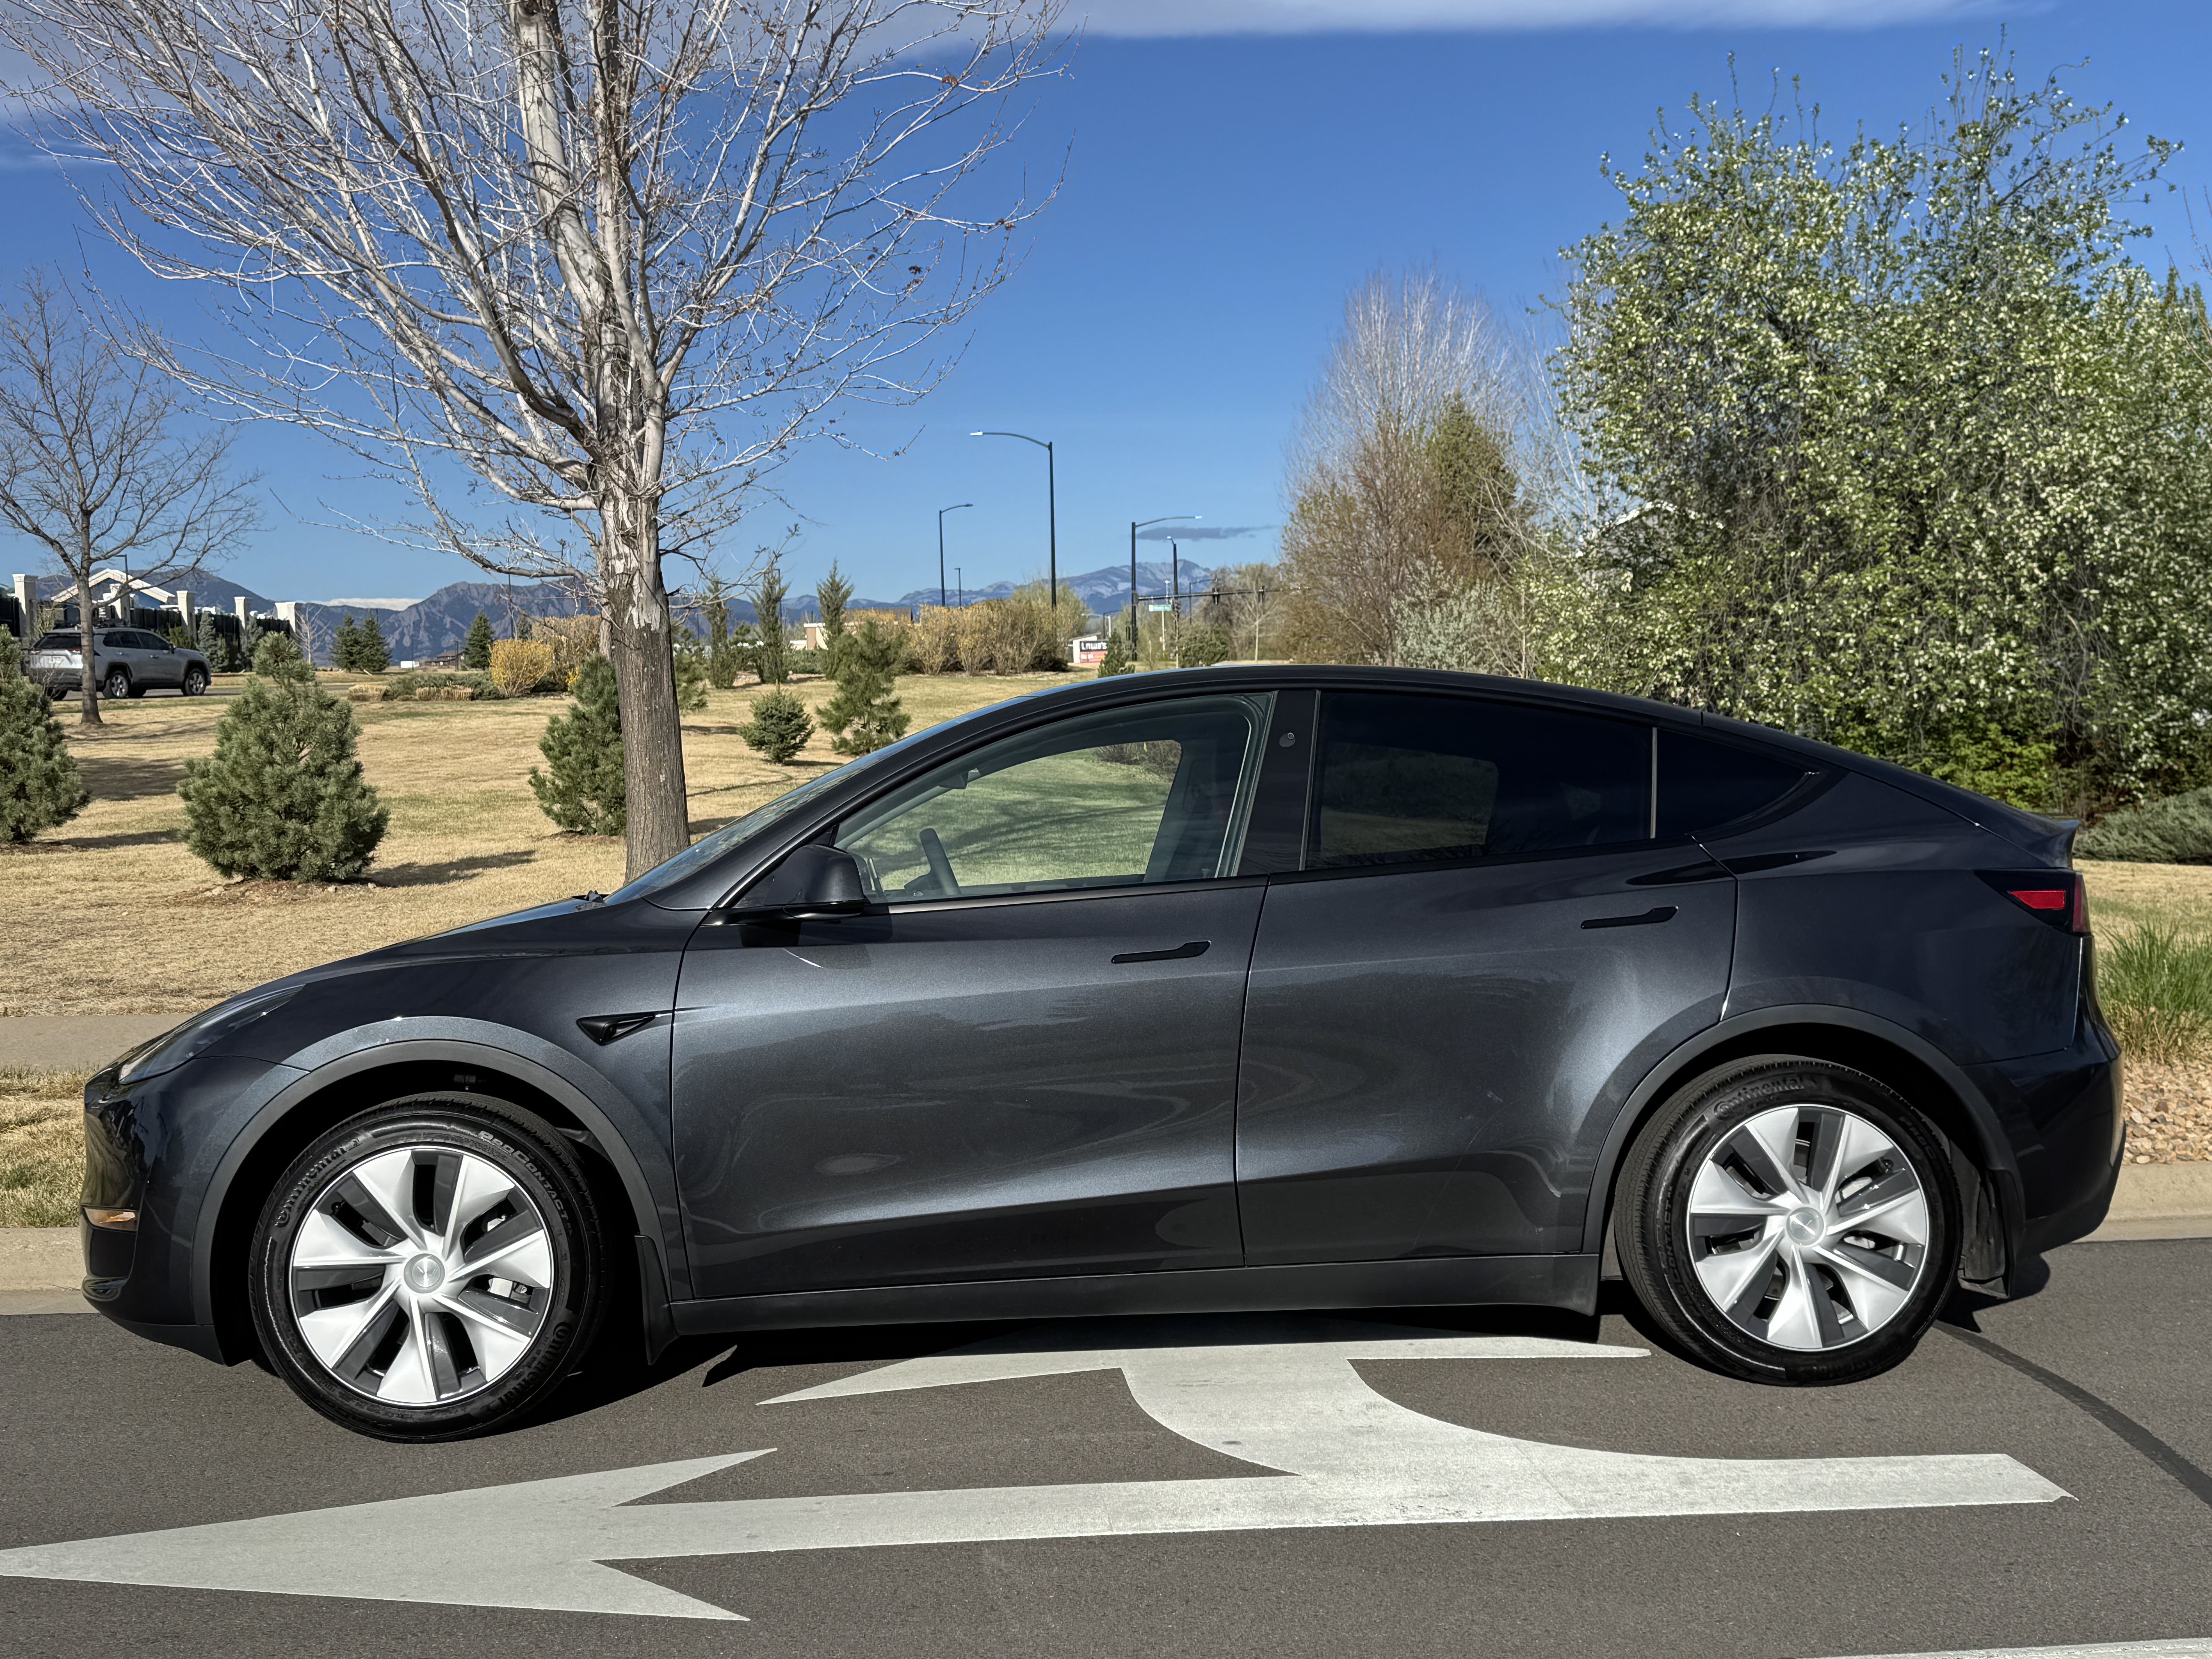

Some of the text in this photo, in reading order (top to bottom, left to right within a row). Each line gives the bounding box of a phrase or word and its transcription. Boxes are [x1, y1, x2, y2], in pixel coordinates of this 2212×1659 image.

[1713, 1075, 1805, 1120] Continental
[274, 1146, 348, 1228] Continental
[498, 1321, 572, 1411] Continental
